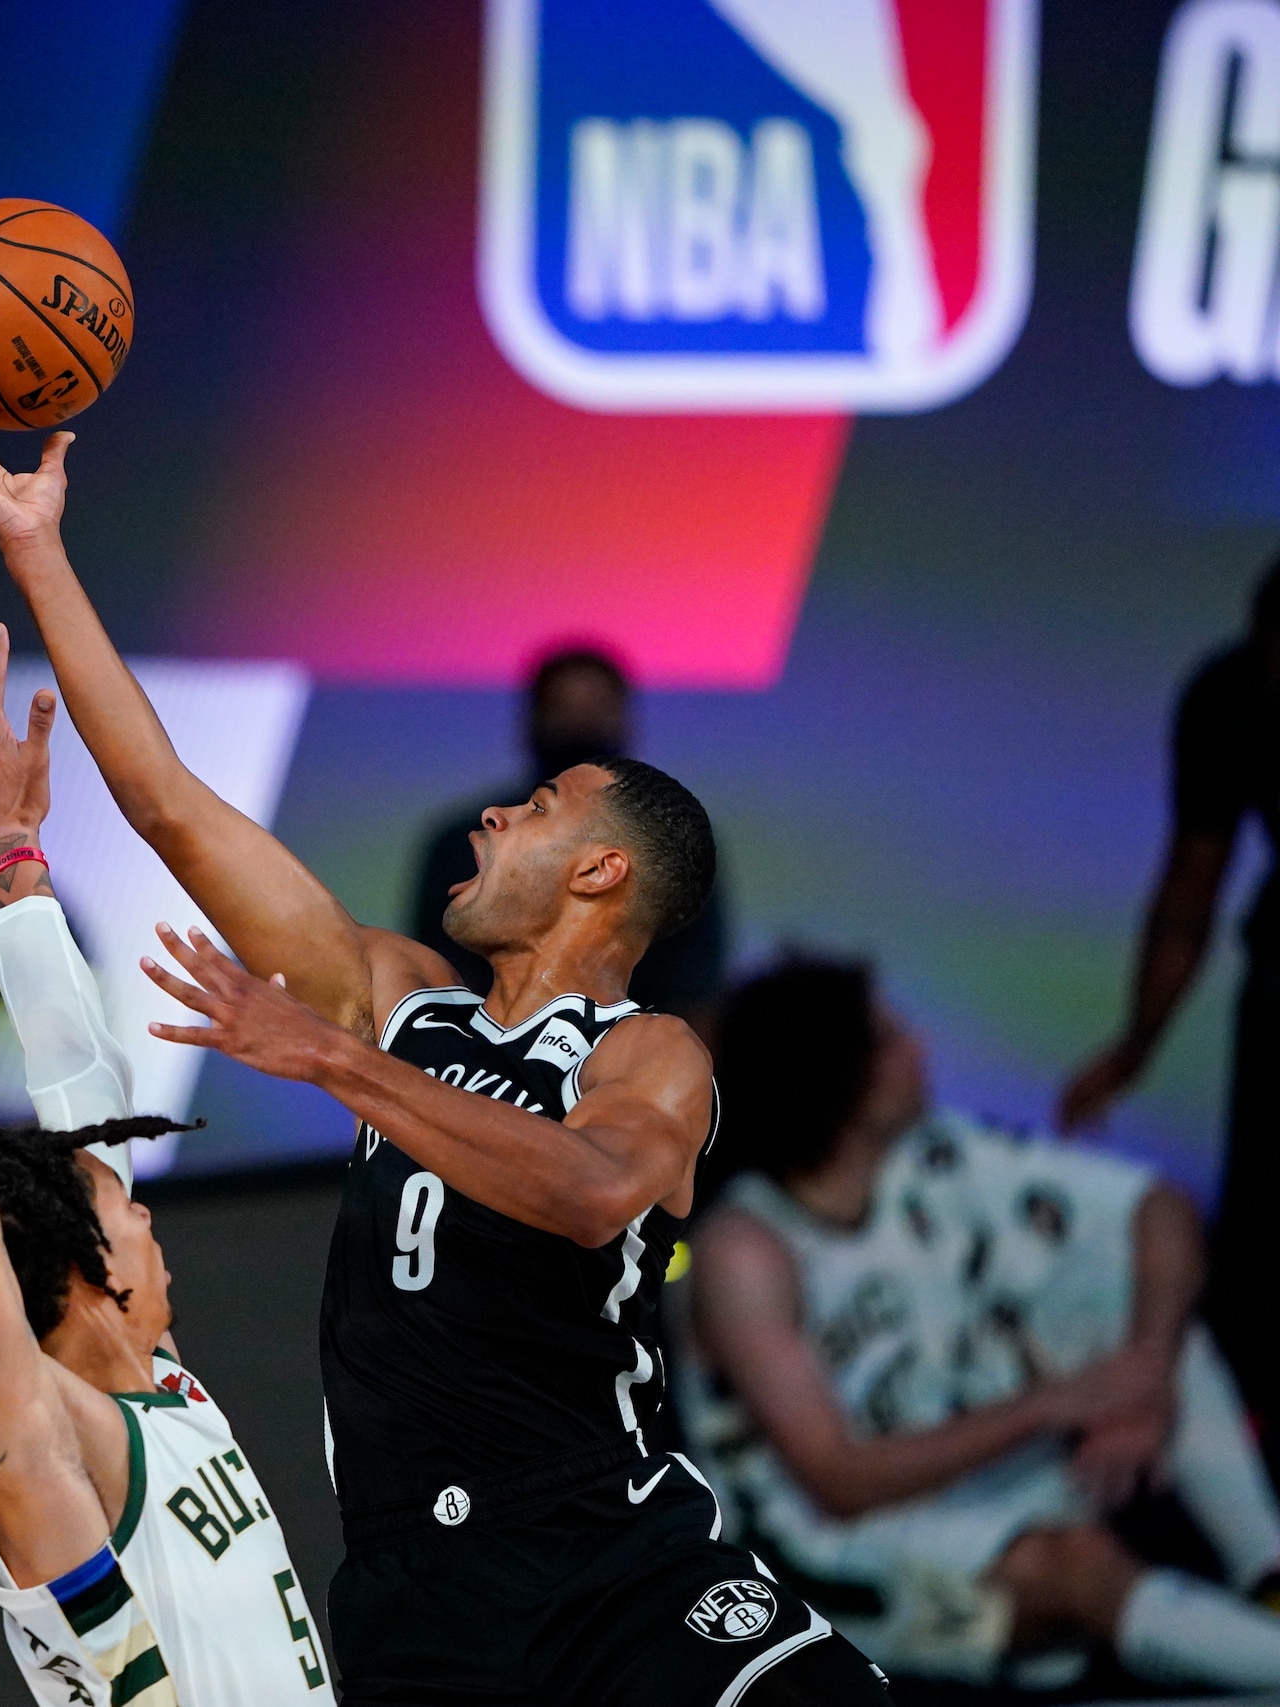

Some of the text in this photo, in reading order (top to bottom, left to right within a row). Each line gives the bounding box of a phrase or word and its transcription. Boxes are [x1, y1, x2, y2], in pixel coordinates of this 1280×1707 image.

[566, 116, 826, 323] NBA
[41, 274, 128, 374] SPALDIN
[538, 1031, 580, 1058] infor
[392, 1171, 445, 1292] 9
[445, 1491, 460, 1521] B
[271, 1567, 327, 1691] 5
[690, 1581, 771, 1634] NETS
[733, 1607, 758, 1630] B
